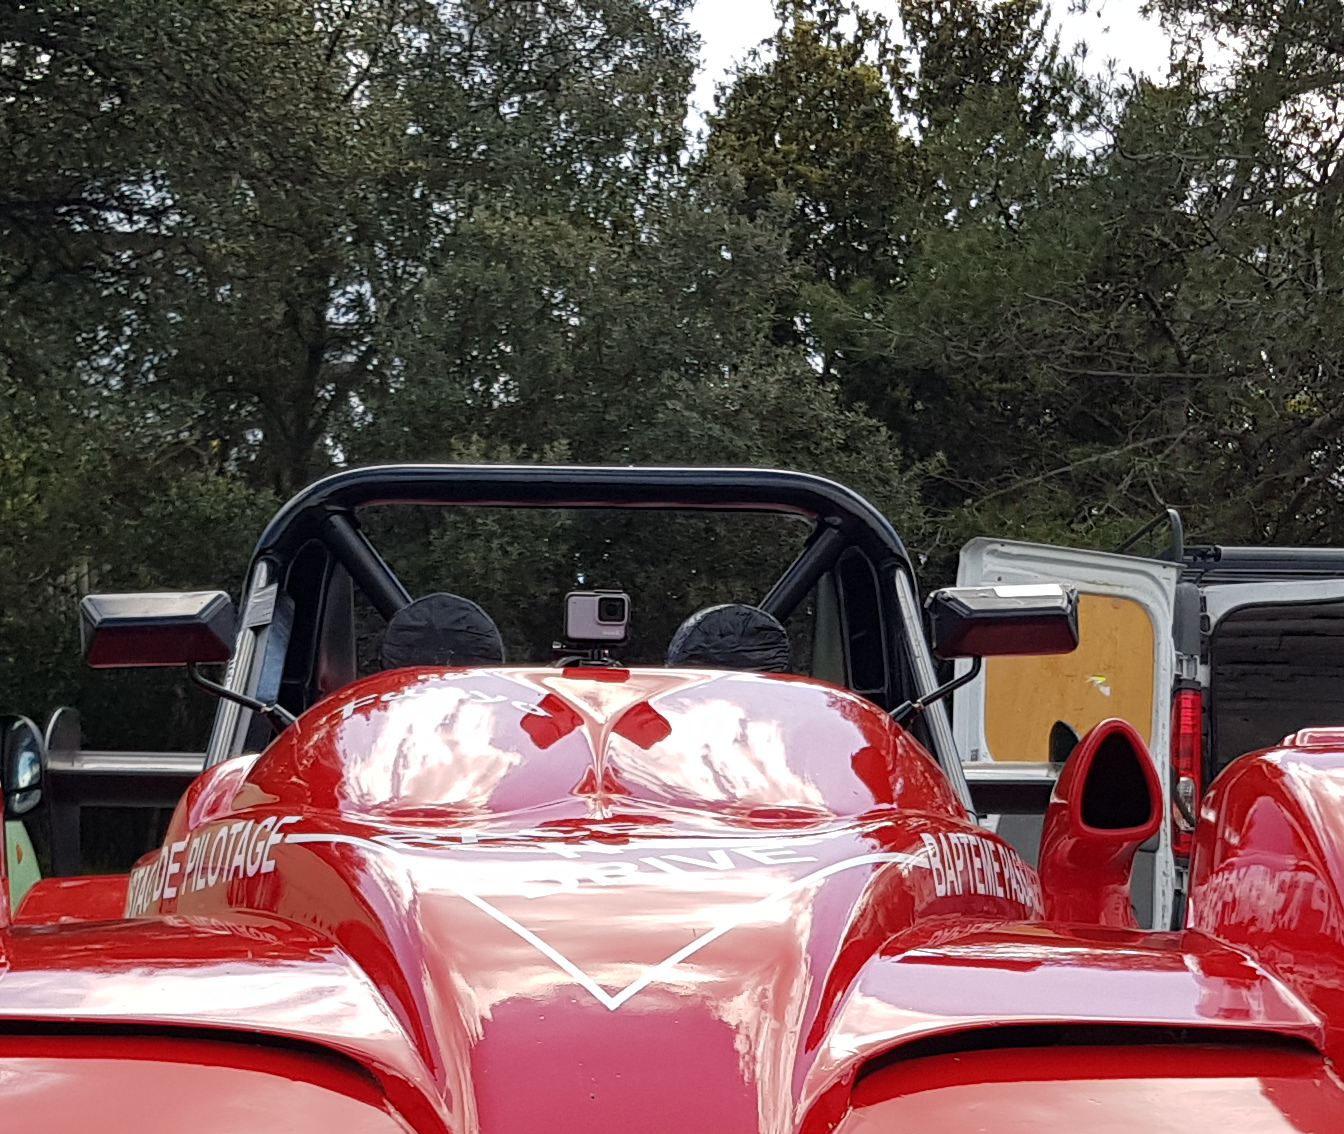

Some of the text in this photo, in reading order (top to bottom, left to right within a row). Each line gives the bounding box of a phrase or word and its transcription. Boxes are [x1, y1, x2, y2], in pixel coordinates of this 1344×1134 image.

[152, 833, 190, 902] DE
[181, 815, 304, 896] PILOTAGE
[920, 832, 1004, 898] BAPTEME
